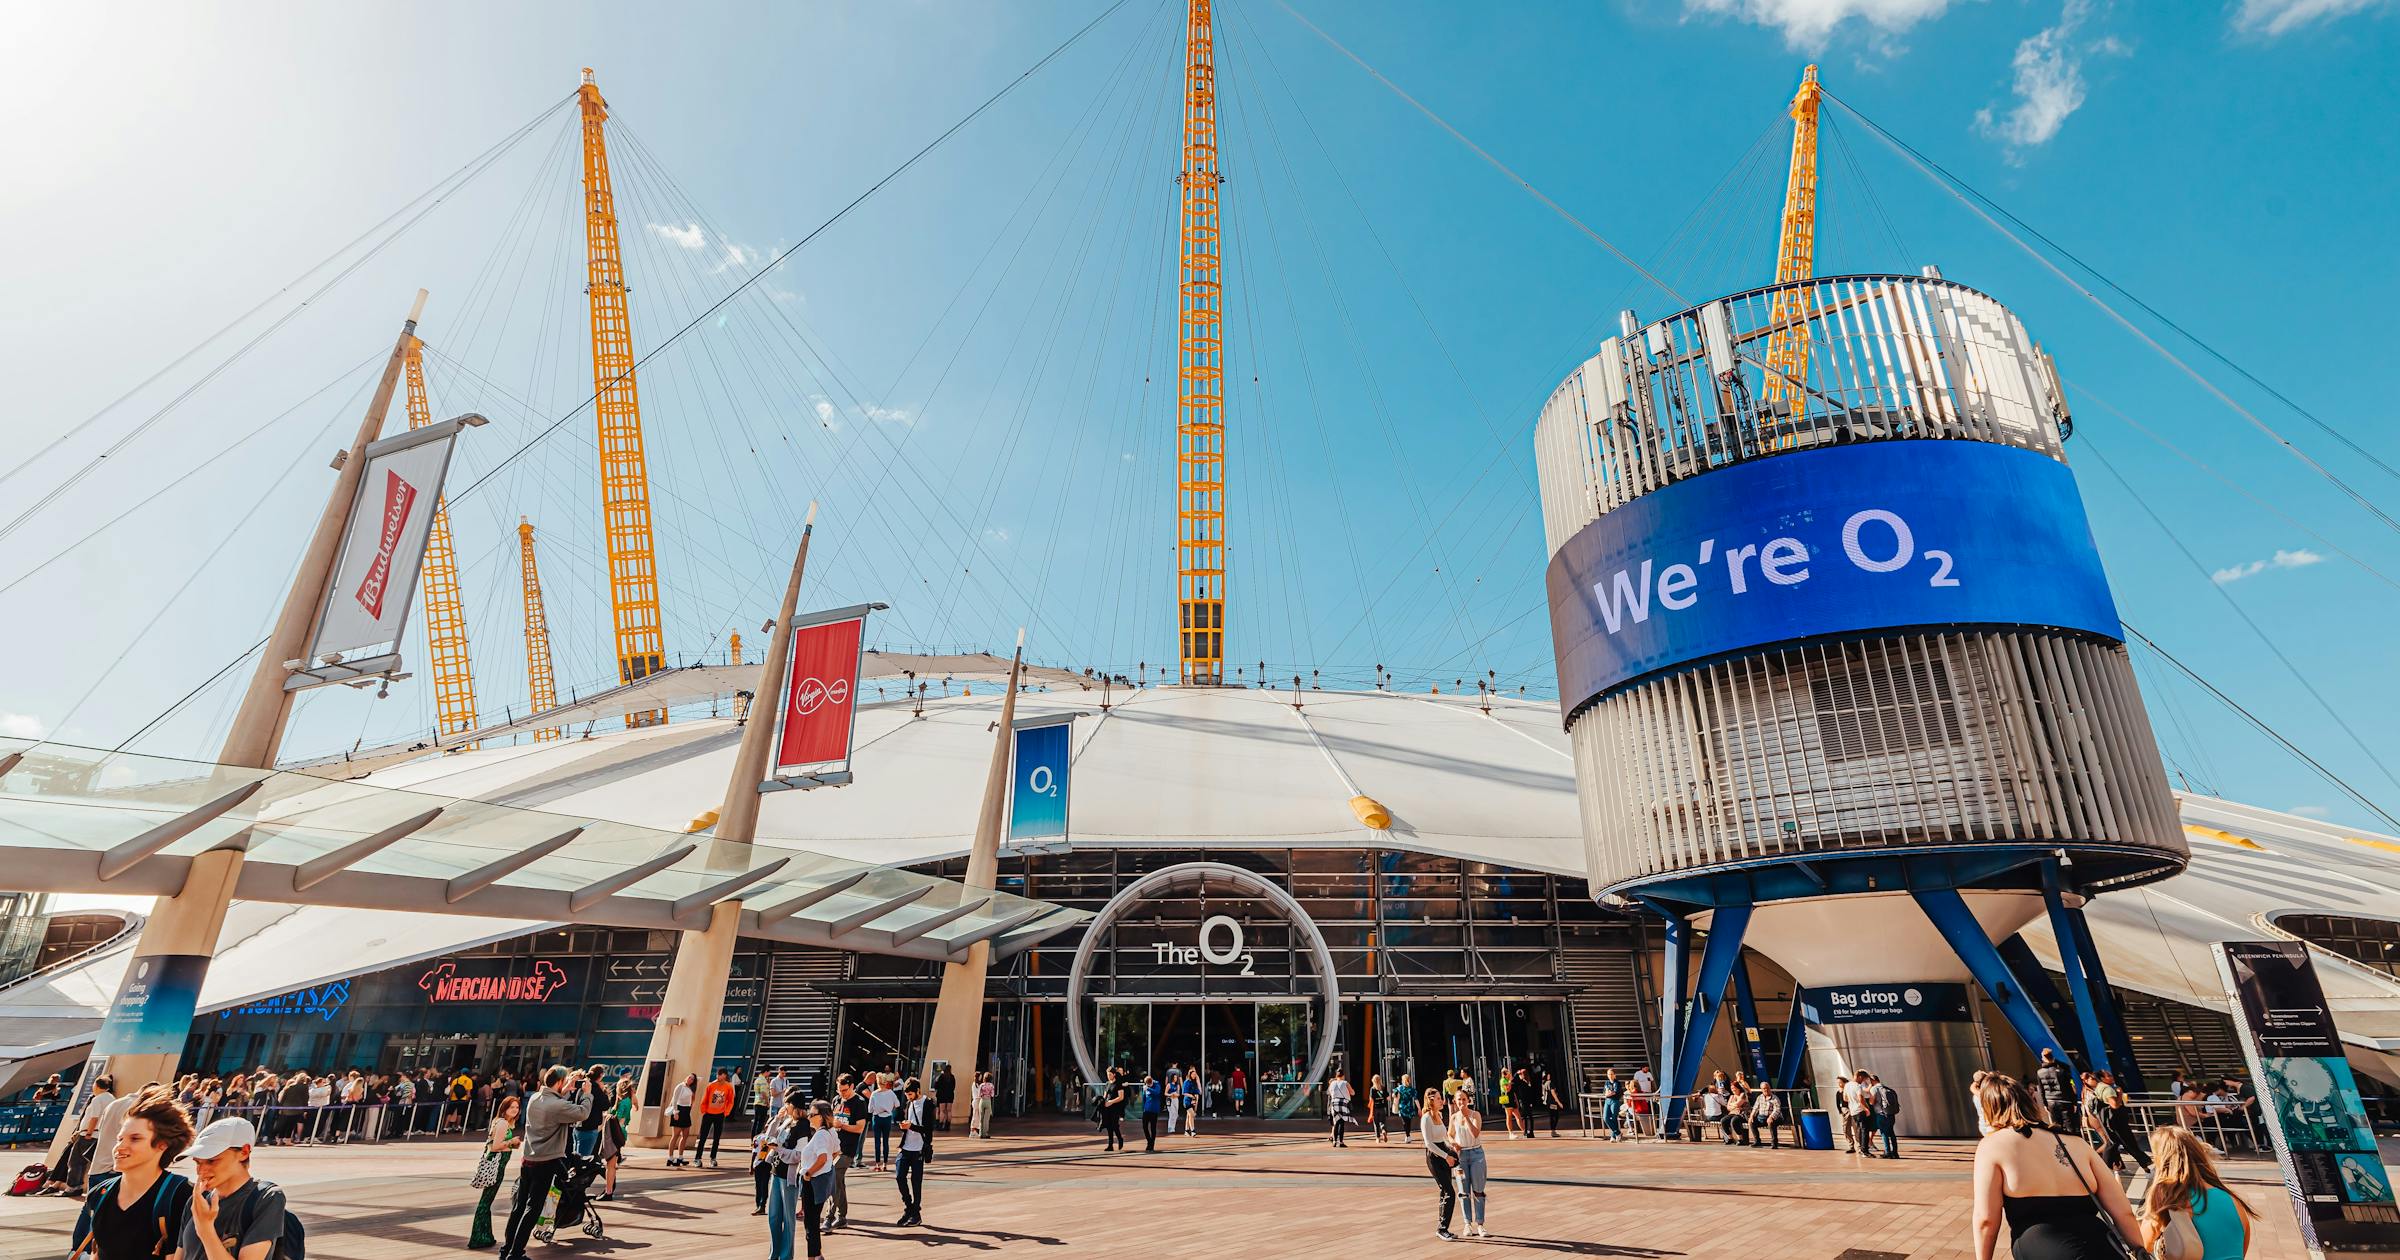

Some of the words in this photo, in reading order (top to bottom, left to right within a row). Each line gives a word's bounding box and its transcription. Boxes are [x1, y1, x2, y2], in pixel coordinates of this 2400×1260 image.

[359, 478, 408, 613] Budweiser
[1841, 508, 1960, 588] O2
[800, 684, 822, 708] Virgin
[1029, 765, 1057, 798] O2
[1151, 941, 1199, 966] The
[120, 995, 149, 1007] shopping?
[128, 983, 147, 995] Going
[436, 976, 546, 1001] MERCHANDISE
[1830, 991, 1858, 1008] Bag
[1861, 989, 1898, 1006] drop
